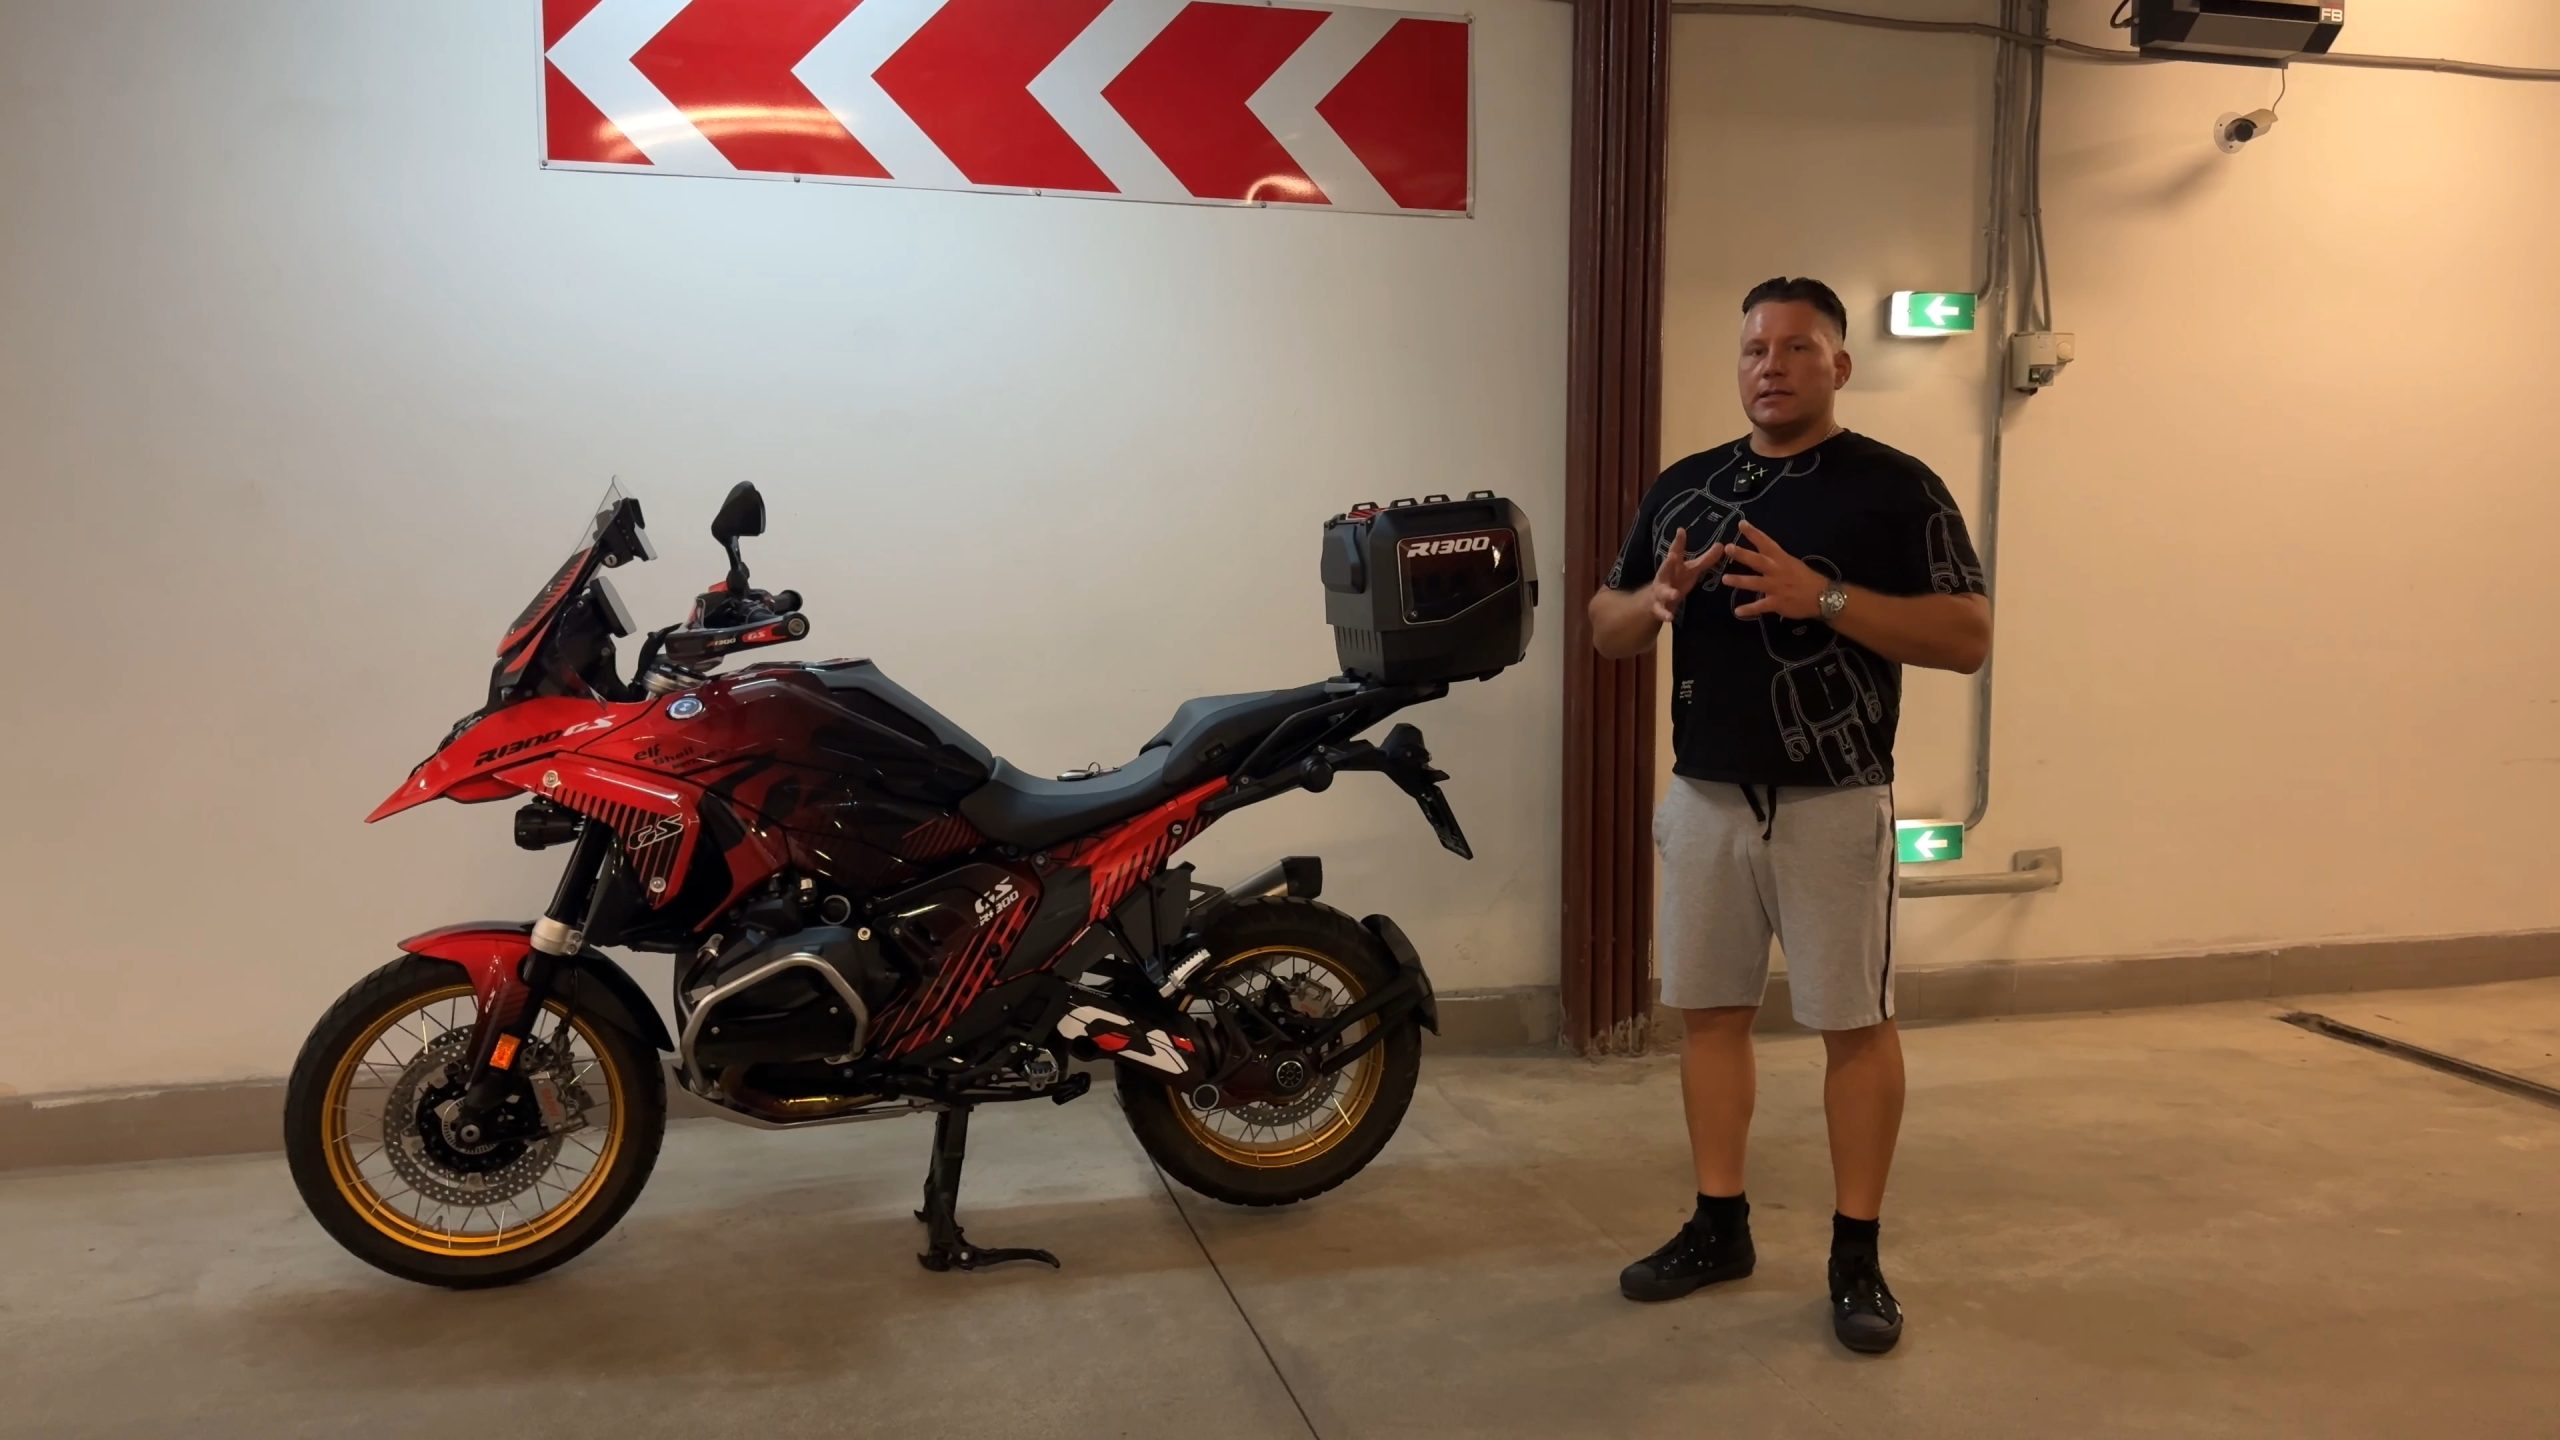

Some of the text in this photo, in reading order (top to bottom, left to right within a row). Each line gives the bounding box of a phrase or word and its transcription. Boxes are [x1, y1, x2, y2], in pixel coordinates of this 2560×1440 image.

[2321, 7, 2343, 22] FB
[1406, 536, 1490, 557] R1300
[746, 630, 767, 640] GS
[474, 704, 617, 768] R1300 GS
[634, 743, 661, 761] elf
[628, 812, 684, 850] GS
[974, 875, 1013, 914] GS
